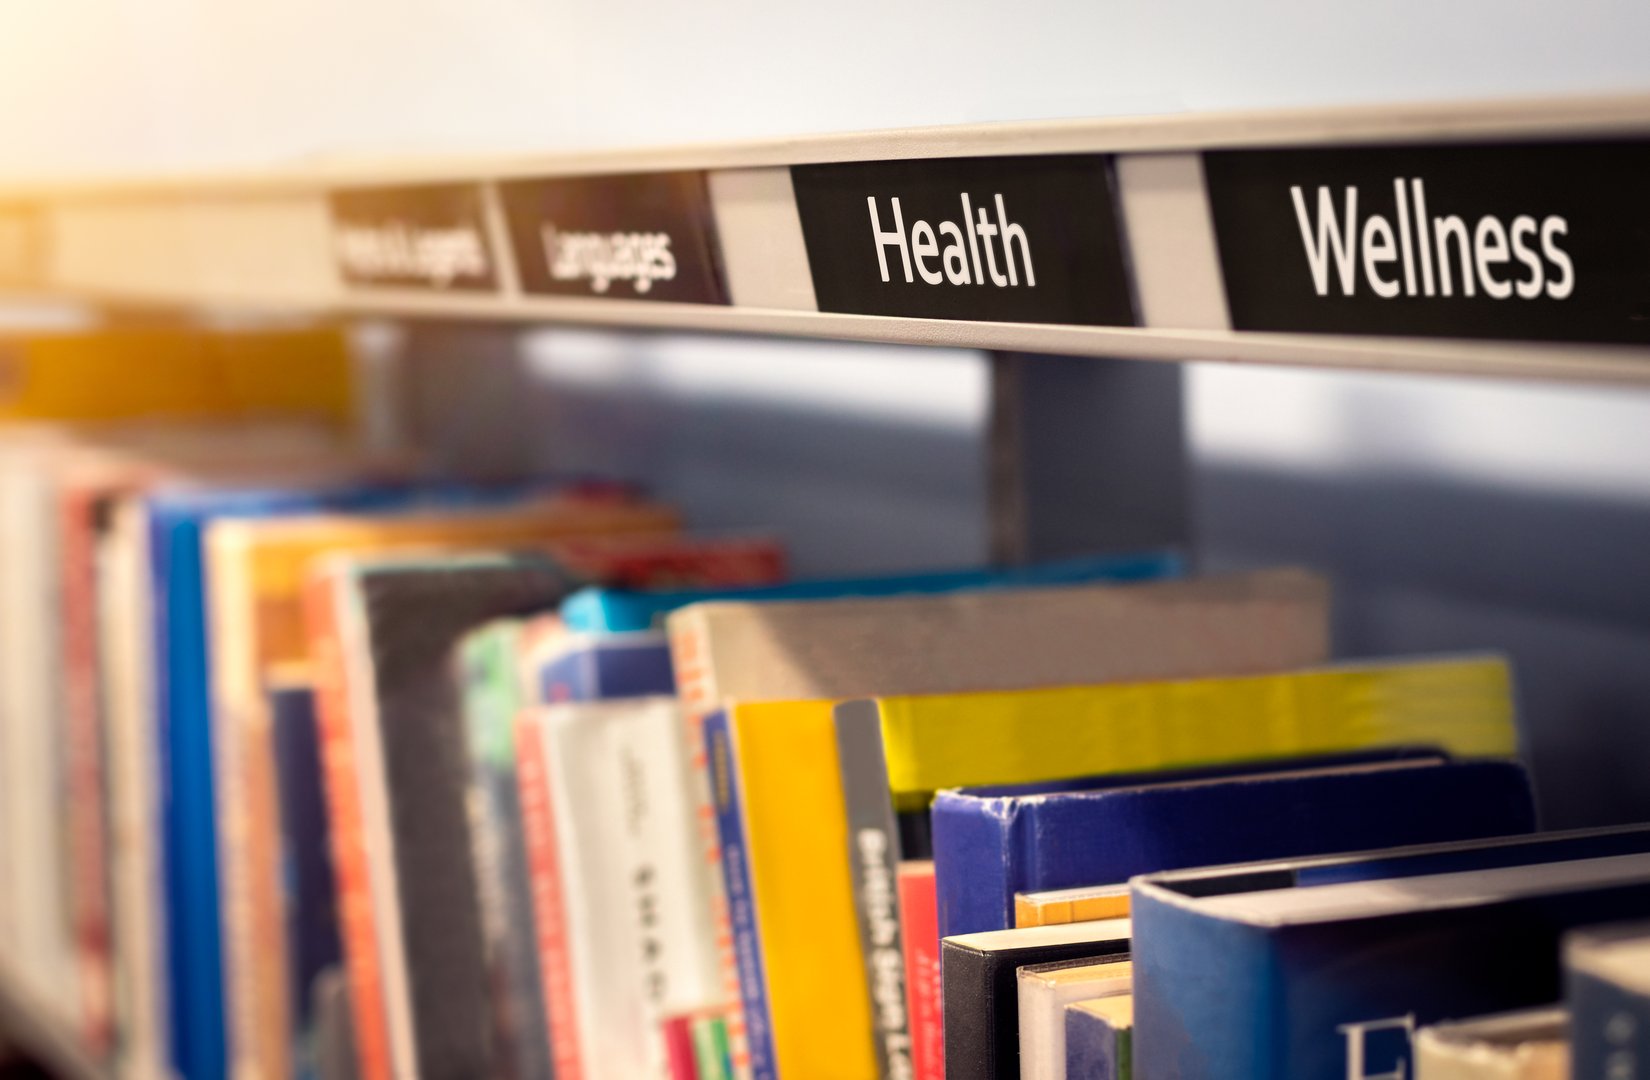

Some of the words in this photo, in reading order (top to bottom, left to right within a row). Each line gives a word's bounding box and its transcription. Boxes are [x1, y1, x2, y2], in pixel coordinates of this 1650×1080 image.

[541, 222, 677, 293] Languages
[866, 192, 1037, 287] Health
[1290, 177, 1575, 299] Wellness
